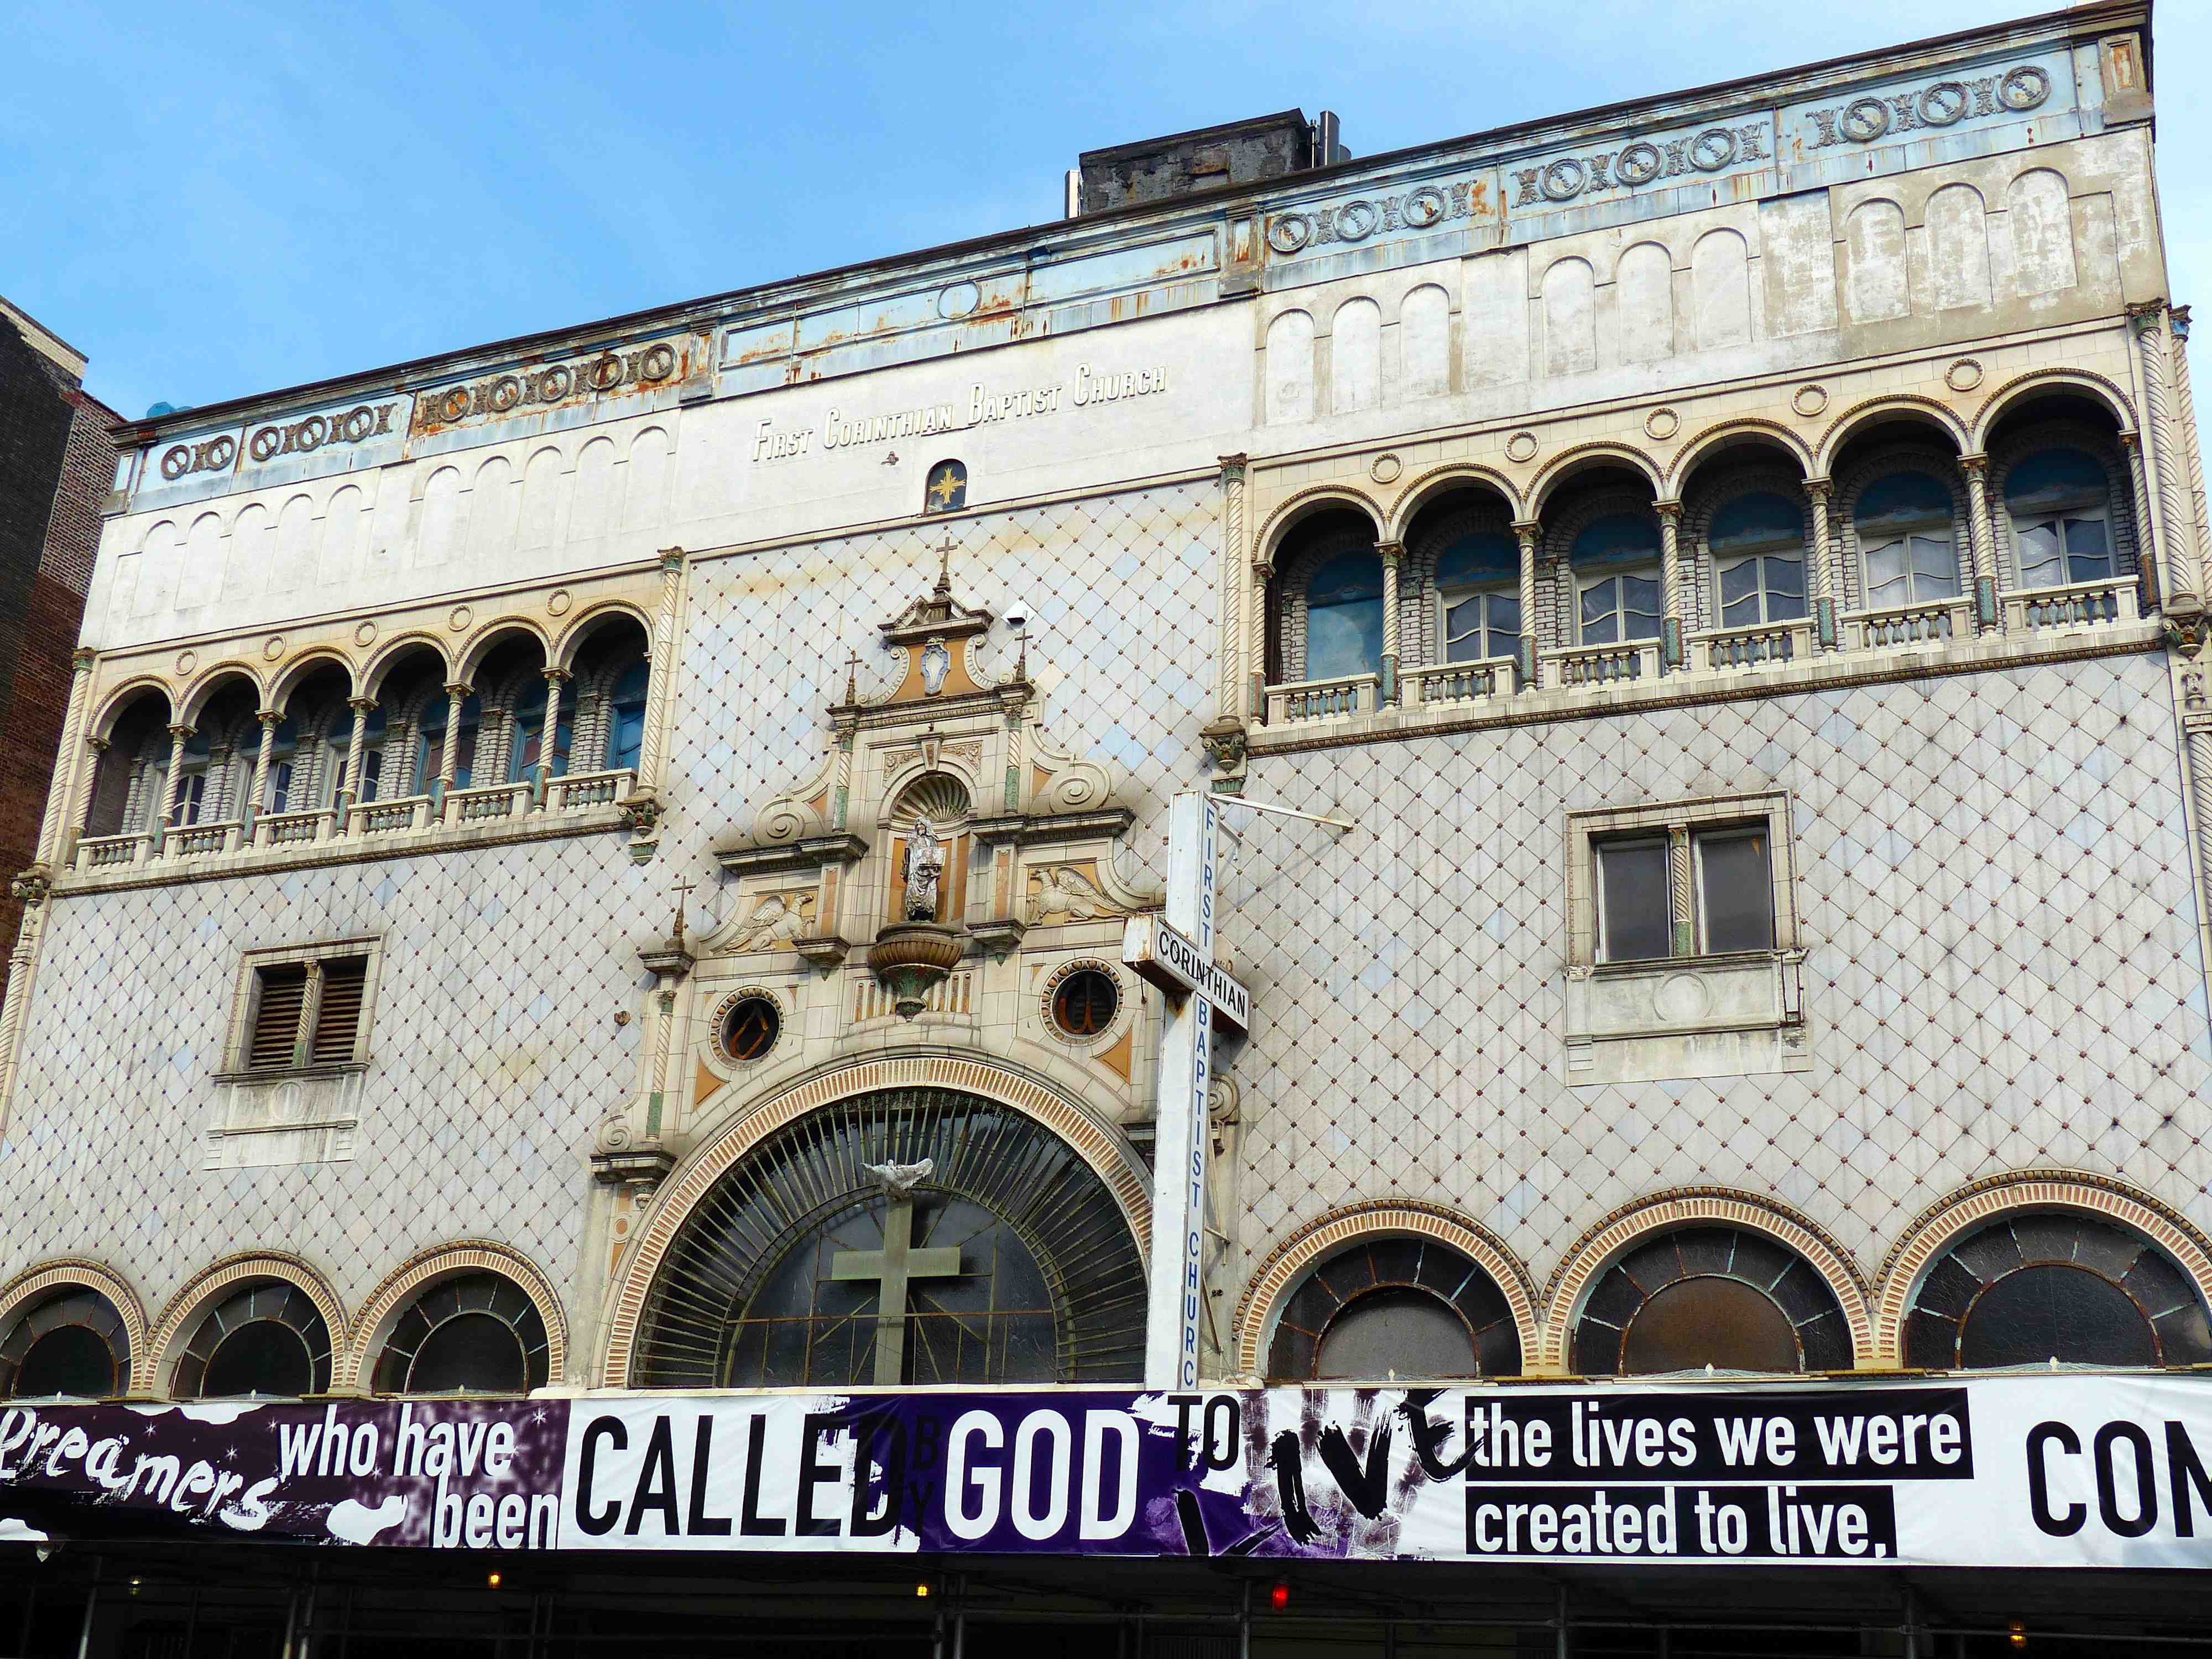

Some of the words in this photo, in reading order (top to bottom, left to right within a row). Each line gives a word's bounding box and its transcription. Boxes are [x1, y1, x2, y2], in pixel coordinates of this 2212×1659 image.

[753, 417, 813, 462] FIRST
[823, 405, 954, 449] CORINTHIAN
[968, 382, 1062, 425] BAPTIST
[1074, 363, 1168, 406] CHURCH
[1202, 807, 1215, 947] FIRST
[1159, 931, 1245, 1018] CORINTHIAN
[1192, 999, 1207, 1208] BAPTIST
[280, 1404, 379, 1477] who
[393, 1402, 514, 1477] have
[1167, 1394, 1242, 1472] TO
[1470, 1402, 1552, 1467] the
[1572, 1401, 1698, 1467] lives
[1714, 1416, 1796, 1466] we
[1814, 1413, 1961, 1465] were
[433, 1472, 558, 1549] been
[575, 1413, 907, 1536] CALLED
[944, 1409, 1141, 1541] GOD
[1475, 1486, 1677, 1553] created
[1694, 1491, 1747, 1554] to
